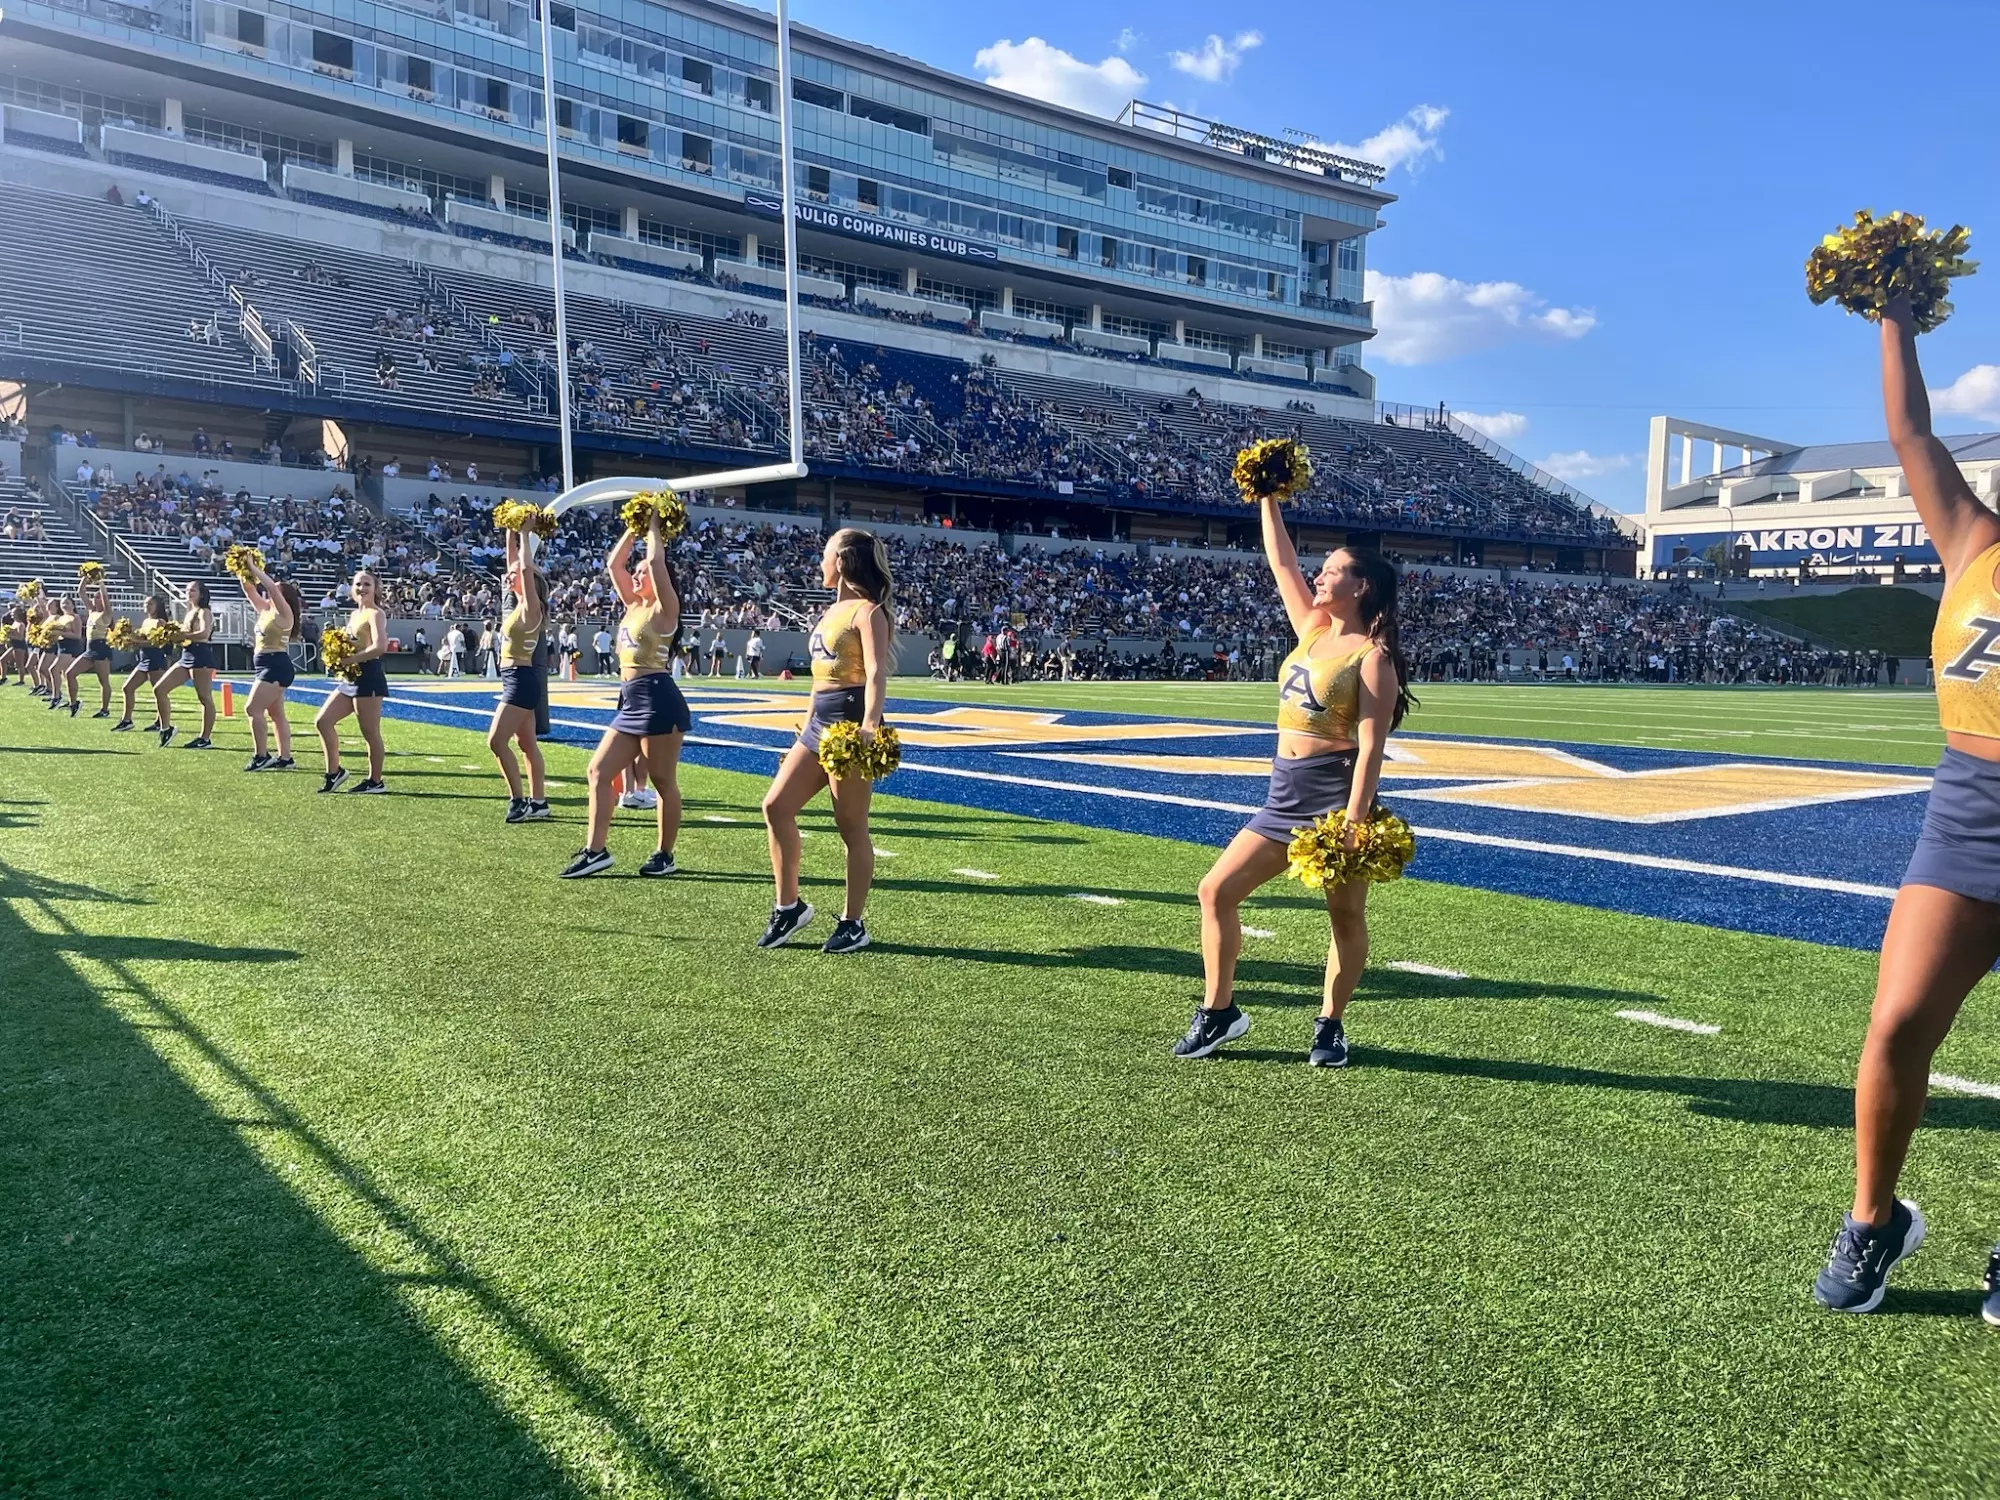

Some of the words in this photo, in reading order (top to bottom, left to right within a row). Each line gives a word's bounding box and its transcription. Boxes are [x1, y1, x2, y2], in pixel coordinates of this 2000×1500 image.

[782, 202, 839, 227] AULIG
[842, 216, 927, 247] COMPANIES
[930, 235, 968, 256] CLUB
[1734, 527, 1863, 552] AKRON
[811, 633, 838, 660] A
[1279, 662, 1328, 713] A
